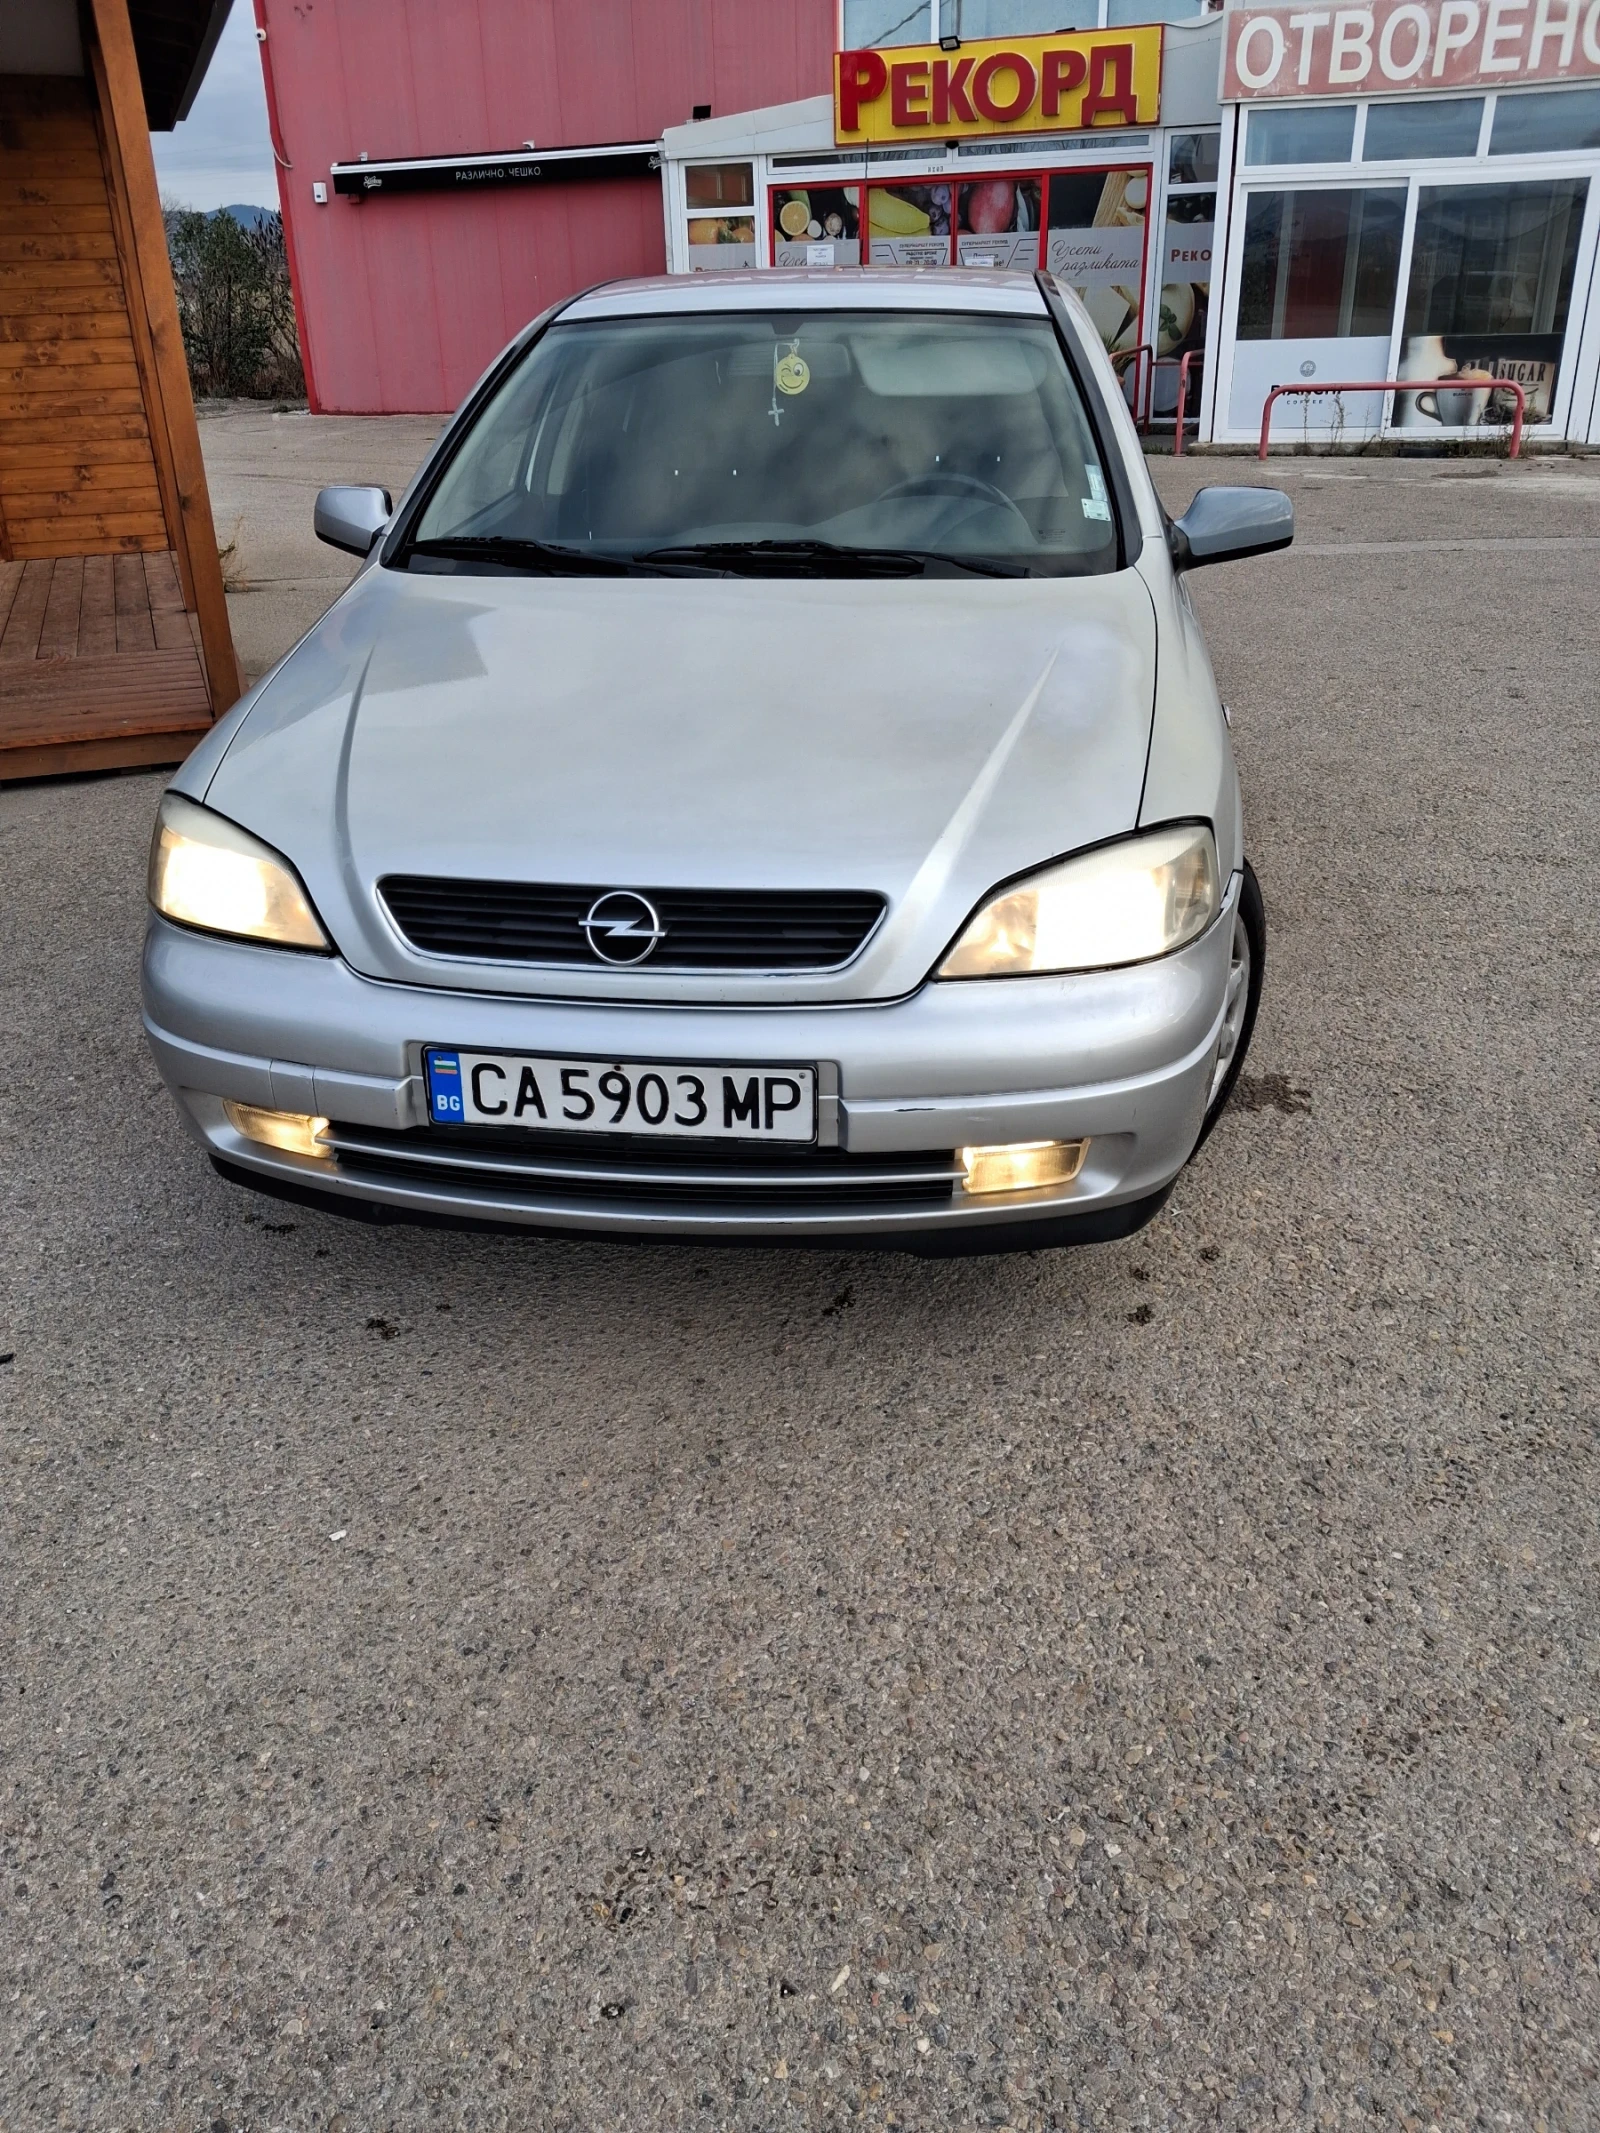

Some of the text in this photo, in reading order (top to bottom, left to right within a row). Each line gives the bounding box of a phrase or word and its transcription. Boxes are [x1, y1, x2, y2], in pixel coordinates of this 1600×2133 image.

[839, 43, 1138, 130] РЕКОРД
[1051, 239, 1102, 263] Усети
[1170, 249, 1212, 262] РЕКО
[1058, 252, 1139, 277] разликата
[1500, 363, 1546, 382] SUGAR
[436, 1095, 461, 1112] BG
[470, 1062, 801, 1131] CA 5903 MP
